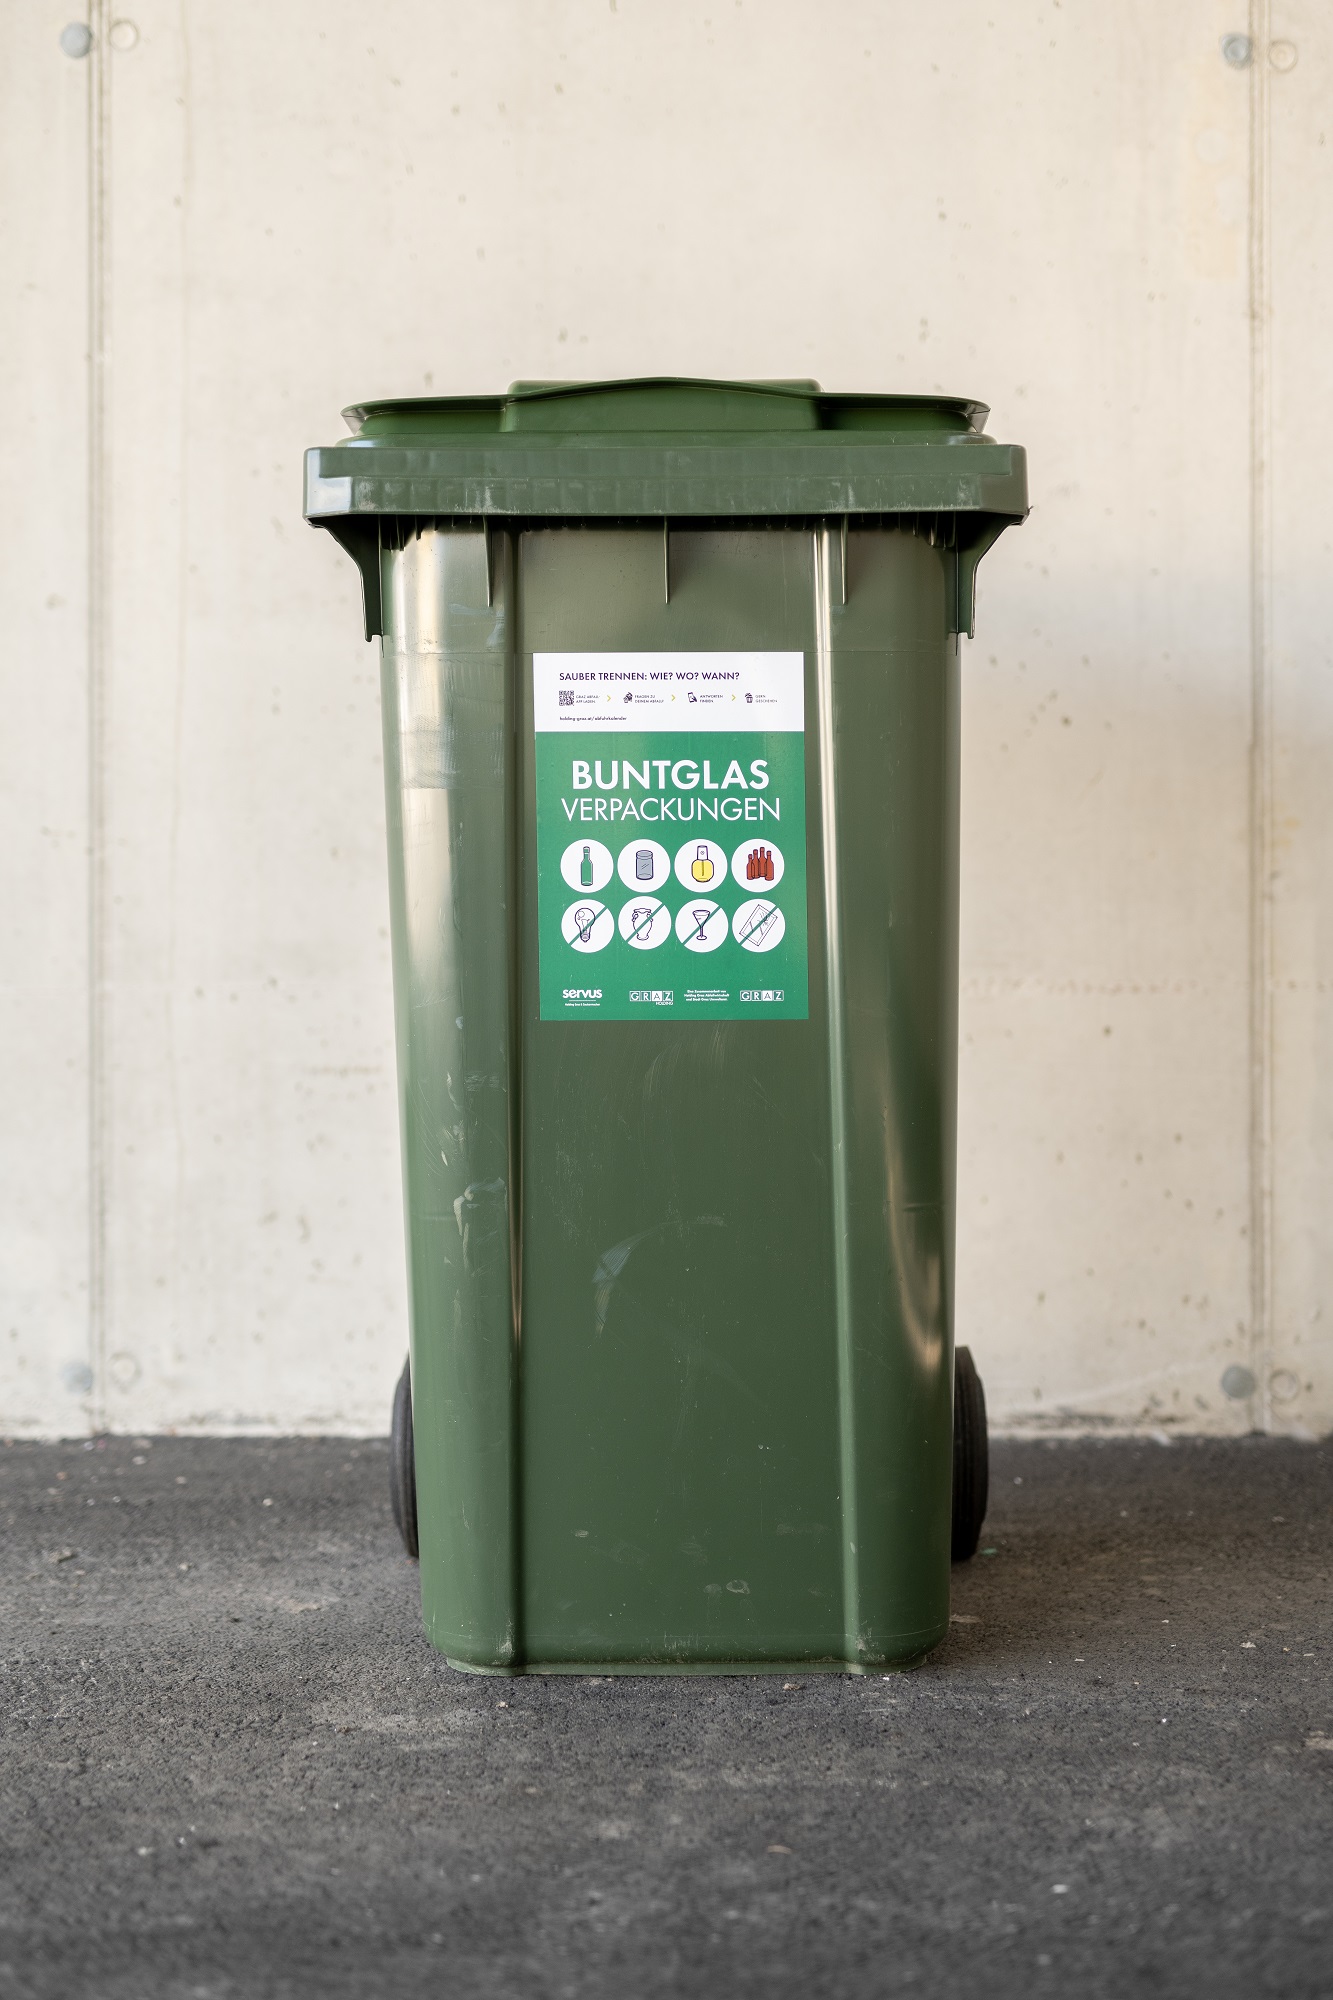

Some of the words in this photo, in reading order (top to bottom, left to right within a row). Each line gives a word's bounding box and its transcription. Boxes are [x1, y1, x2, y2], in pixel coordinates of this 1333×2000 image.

[559, 672, 596, 681] SAUBER
[598, 672, 648, 681] TRENNEN:
[650, 672, 673, 680] WIE?
[676, 672, 699, 681] WO?
[702, 672, 740, 680] WANN?
[572, 759, 770, 790] BUNTGLAS
[561, 797, 780, 822] VERPACKUNGEN
[562, 989, 603, 999] servus
[629, 991, 674, 1002] GRAZ
[740, 990, 784, 1001] GRAZ
